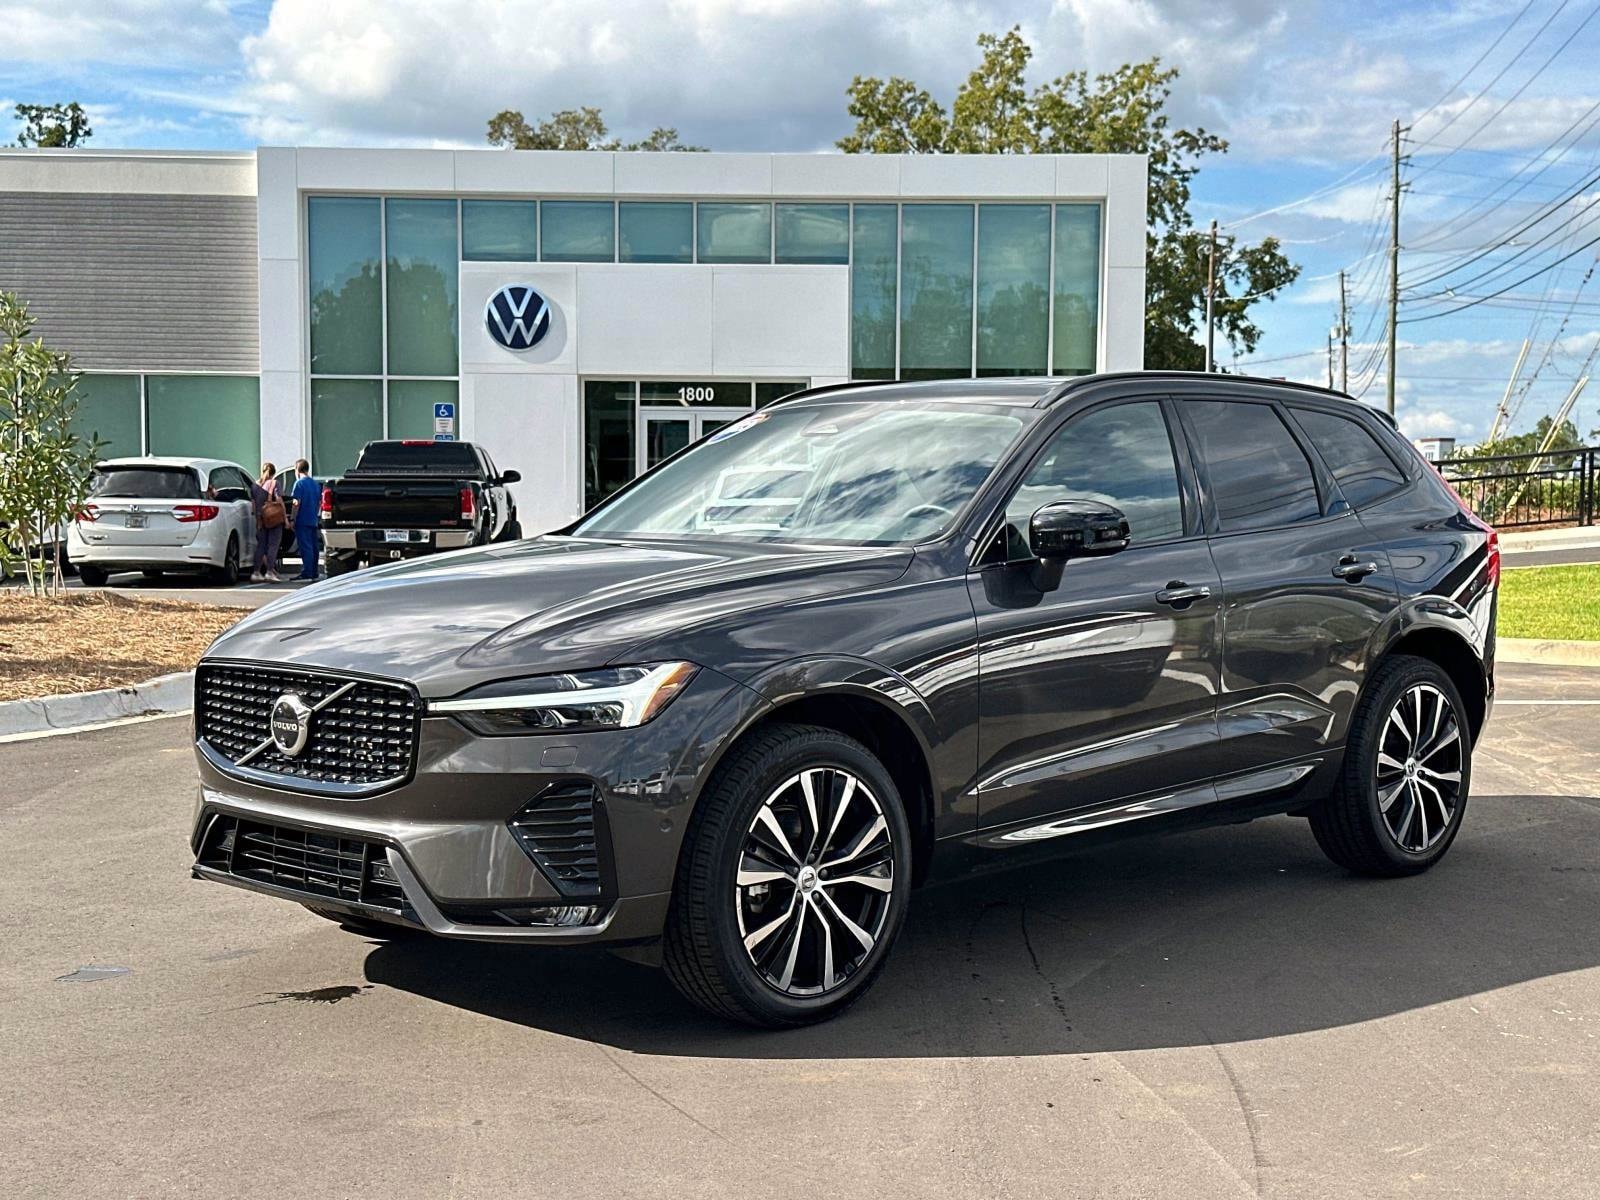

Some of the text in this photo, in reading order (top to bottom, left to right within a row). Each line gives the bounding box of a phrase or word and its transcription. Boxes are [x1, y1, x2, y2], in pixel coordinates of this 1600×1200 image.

[486, 286, 549, 347] VW
[678, 387, 714, 402] 1800
[273, 721, 297, 730] VOLVO
